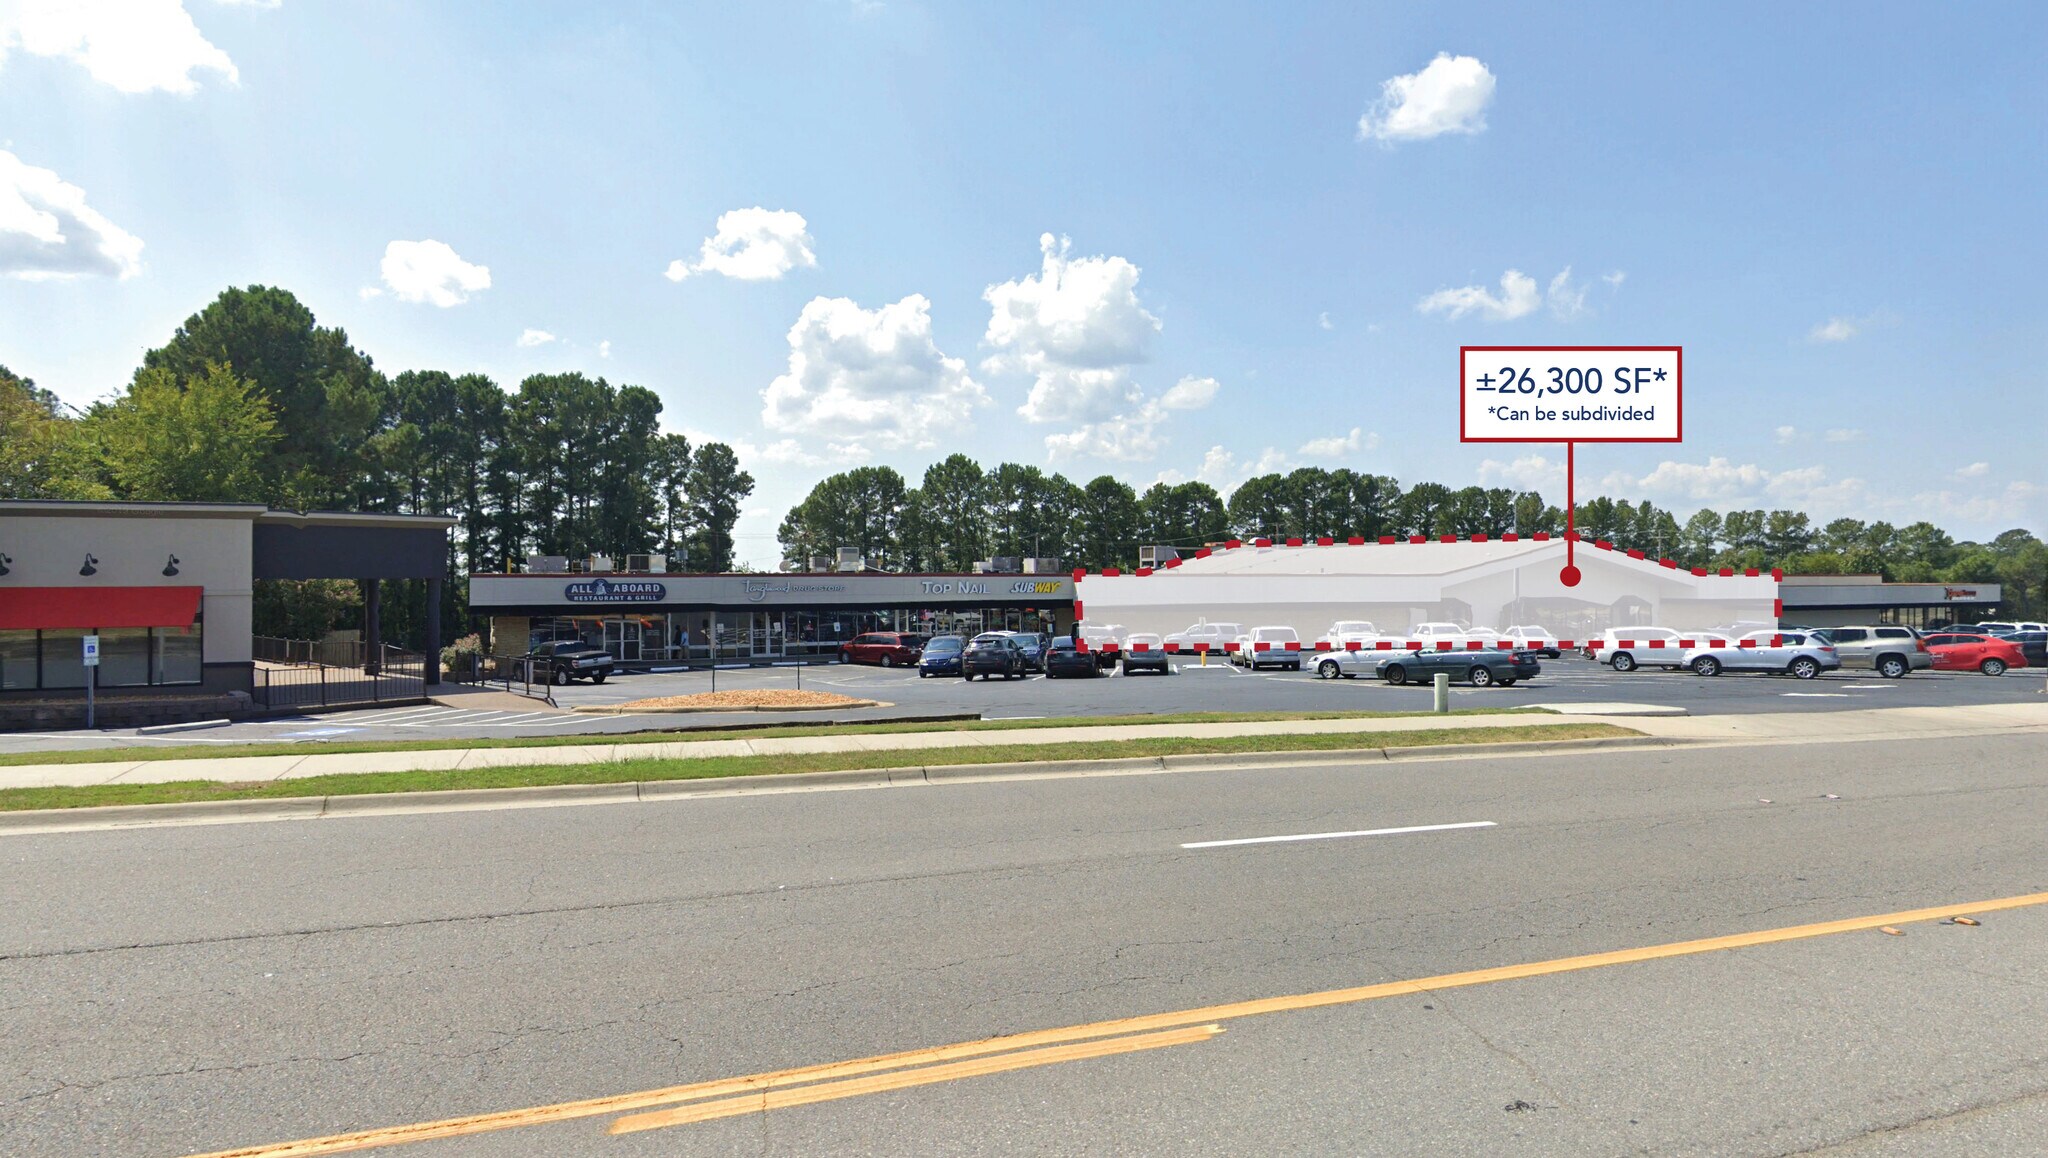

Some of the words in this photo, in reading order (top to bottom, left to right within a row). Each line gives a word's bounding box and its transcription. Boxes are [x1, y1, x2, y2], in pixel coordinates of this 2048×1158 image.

[571, 585, 593, 593] ALL
[613, 584, 661, 593] ABOARD
[793, 585, 817, 593] DRUG
[1011, 582, 1061, 594] SUBWAY
